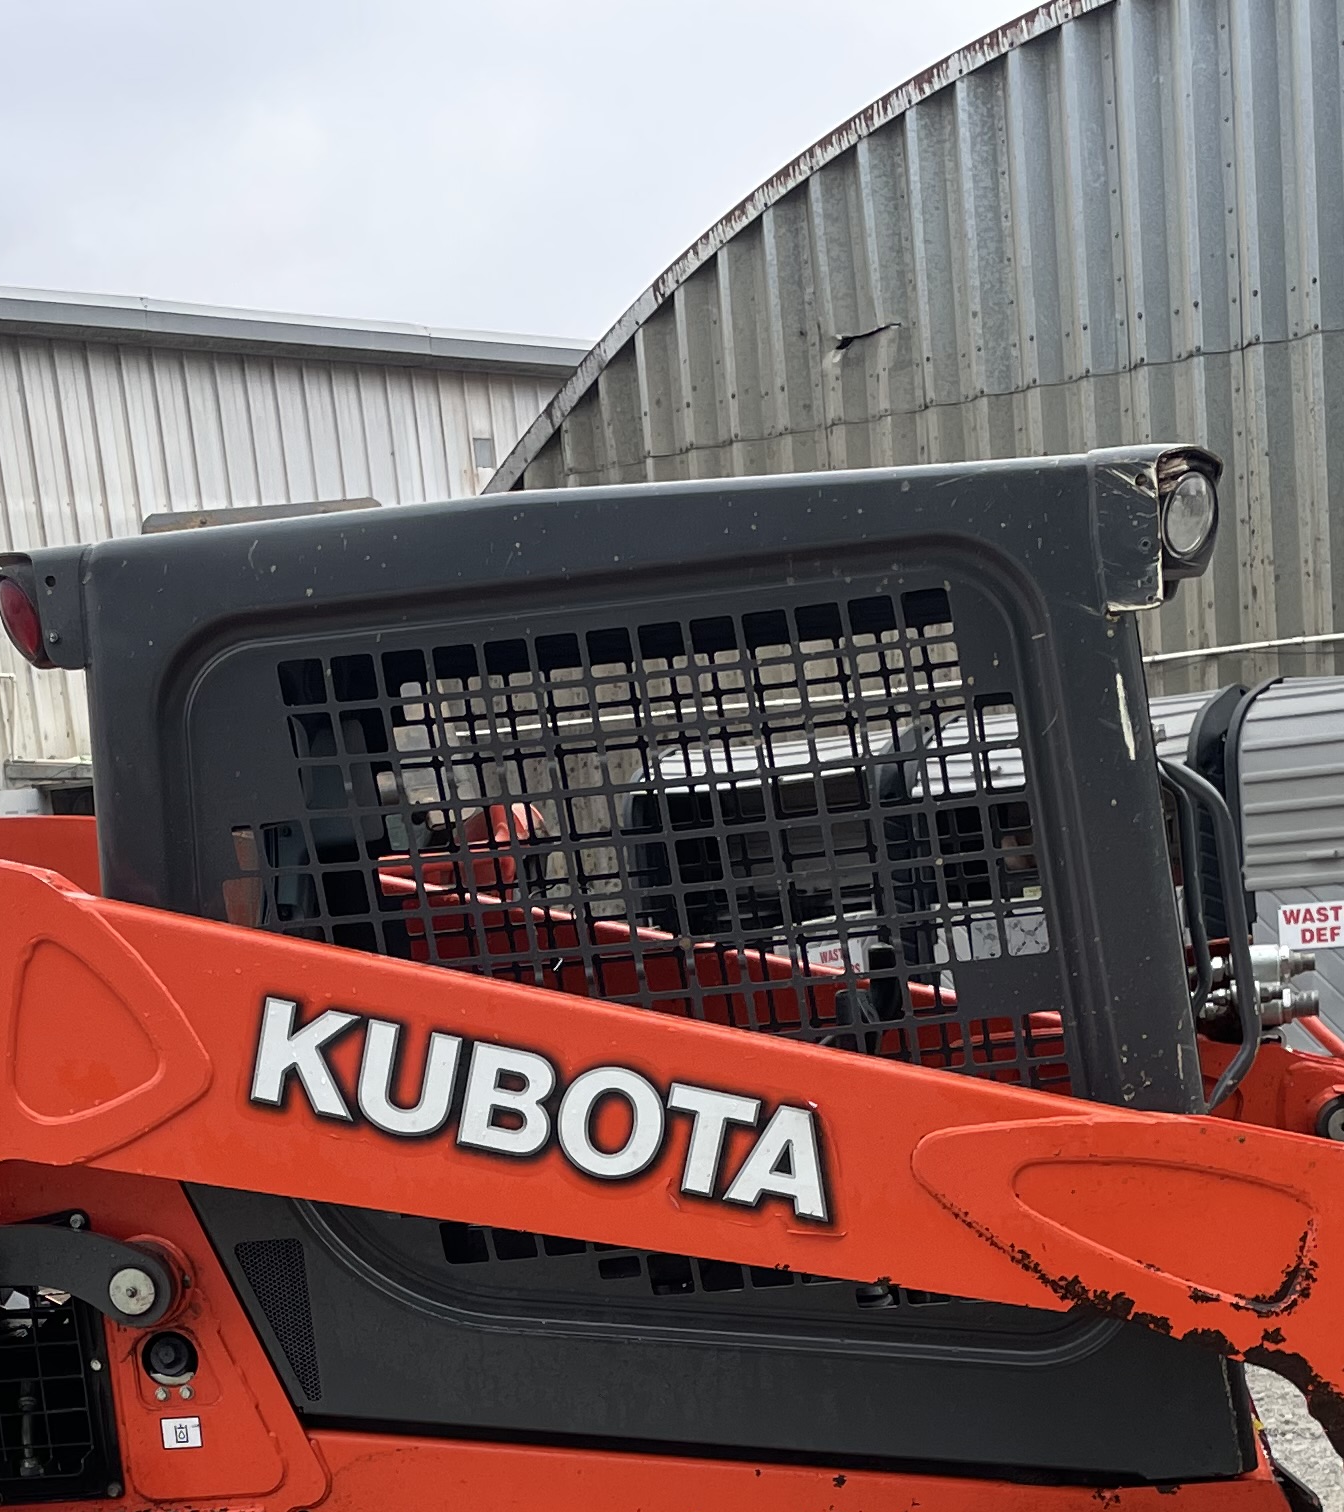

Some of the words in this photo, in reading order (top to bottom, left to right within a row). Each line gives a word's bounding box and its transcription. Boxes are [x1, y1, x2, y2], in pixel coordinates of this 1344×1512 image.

[1300, 926, 1342, 945] DEF
[819, 948, 844, 964] WAST
[250, 995, 831, 1223] KUBOTA
